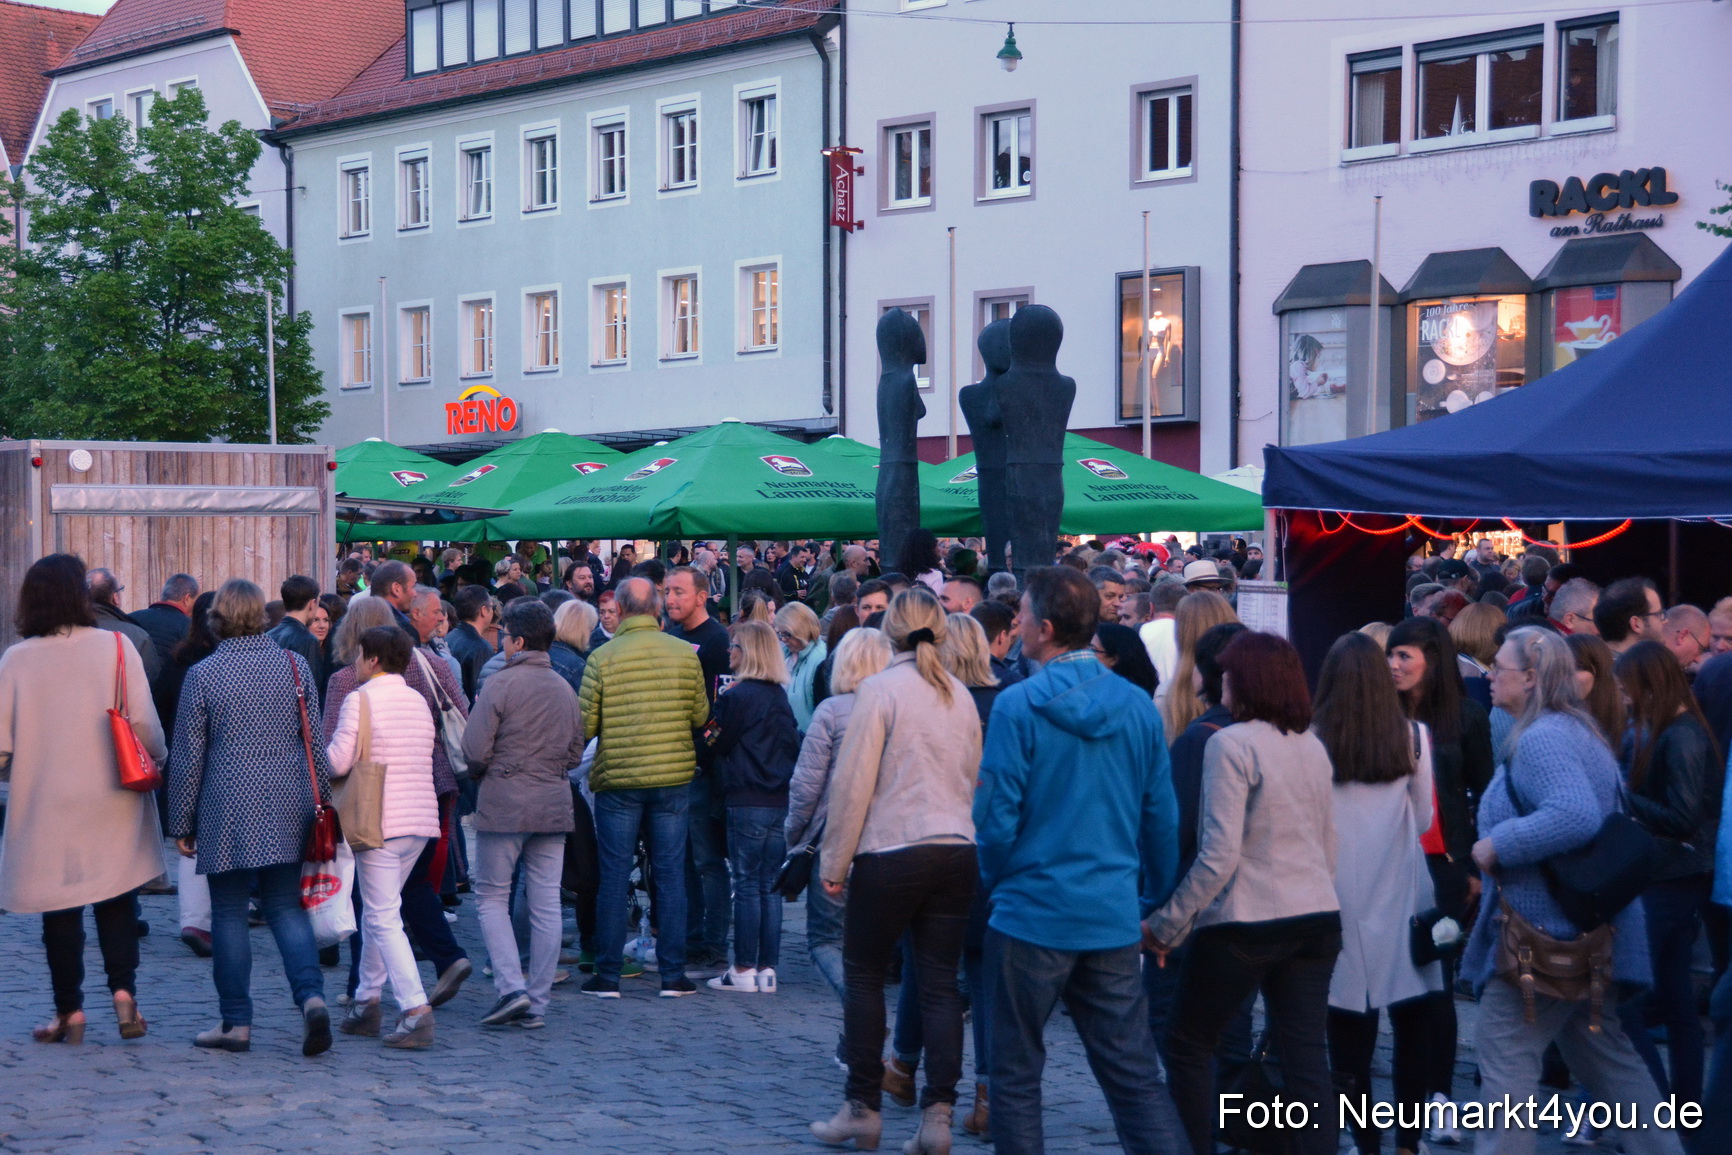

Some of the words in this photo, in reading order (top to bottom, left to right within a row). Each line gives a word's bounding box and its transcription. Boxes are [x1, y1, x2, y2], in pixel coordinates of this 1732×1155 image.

[836, 164, 849, 222] Achatz
[1529, 166, 1679, 218] RACKL
[1550, 225, 1580, 238] am
[1583, 212, 1664, 235] Rathaus
[1425, 306, 1441, 318] 100
[1443, 302, 1469, 316] Jahre
[1421, 318, 1461, 341] RACKL
[444, 397, 518, 435] RENO
[763, 480, 858, 489] Neumarkter
[1082, 490, 1199, 502] Lammsbräu
[1087, 483, 1170, 492] Neumarkter
